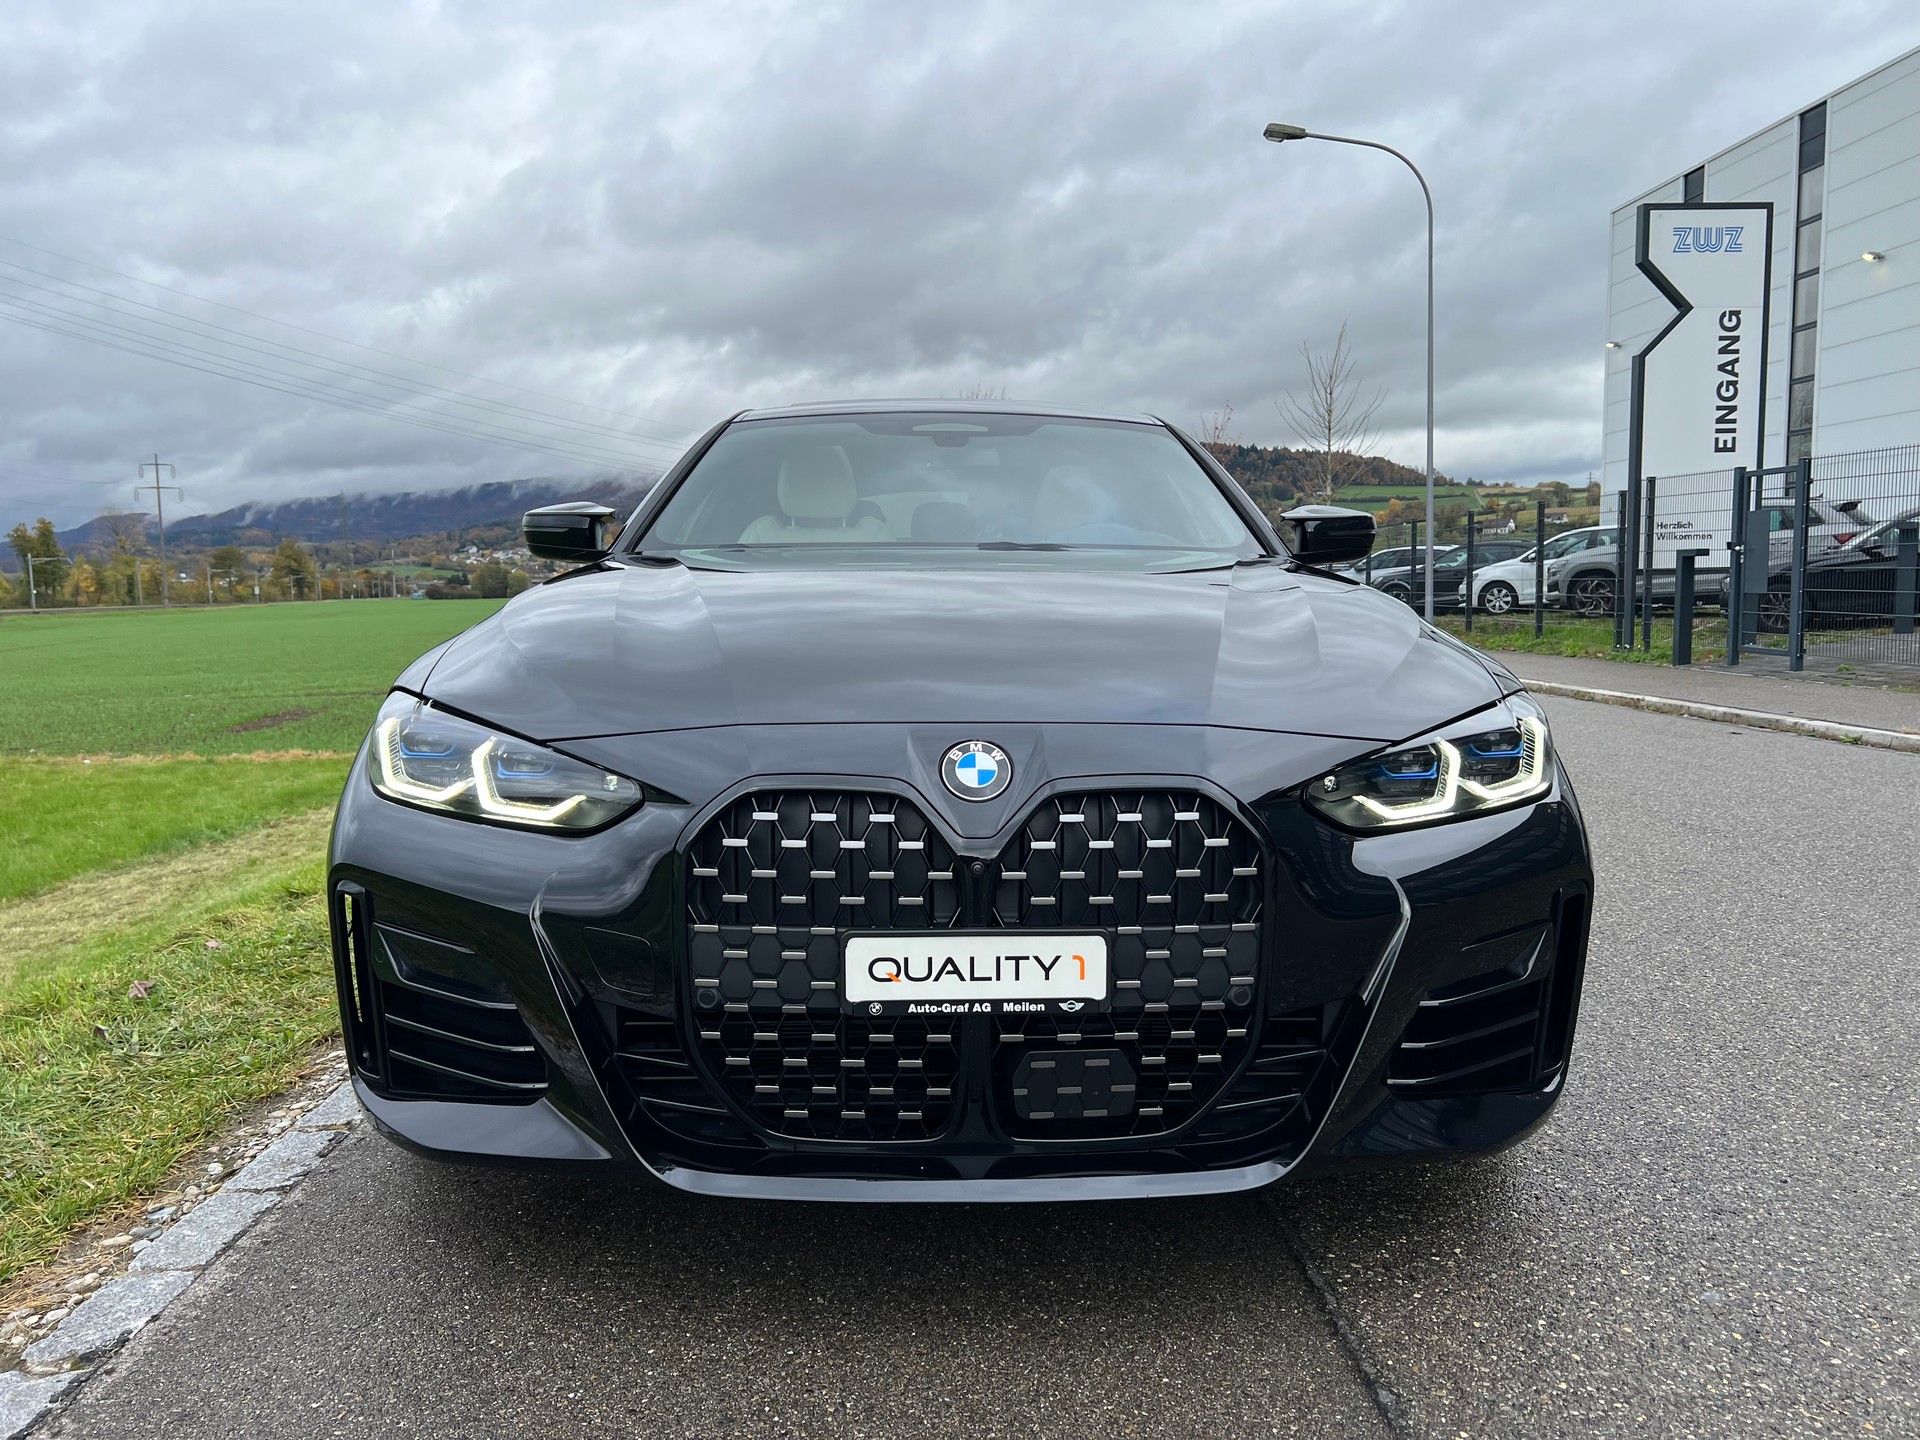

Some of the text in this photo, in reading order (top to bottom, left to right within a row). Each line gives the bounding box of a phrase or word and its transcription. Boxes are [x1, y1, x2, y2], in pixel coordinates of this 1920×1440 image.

[1673, 227, 1744, 253] ZWZ
[1714, 310, 1742, 453] EINGANG
[1657, 521, 1693, 529] Herzlich
[1656, 532, 1712, 540] Willkommen
[949, 743, 1004, 761] BMW
[868, 955, 1085, 982] QUALITY 1
[907, 1002, 1045, 1013] Auto-Graf AG Meilen
